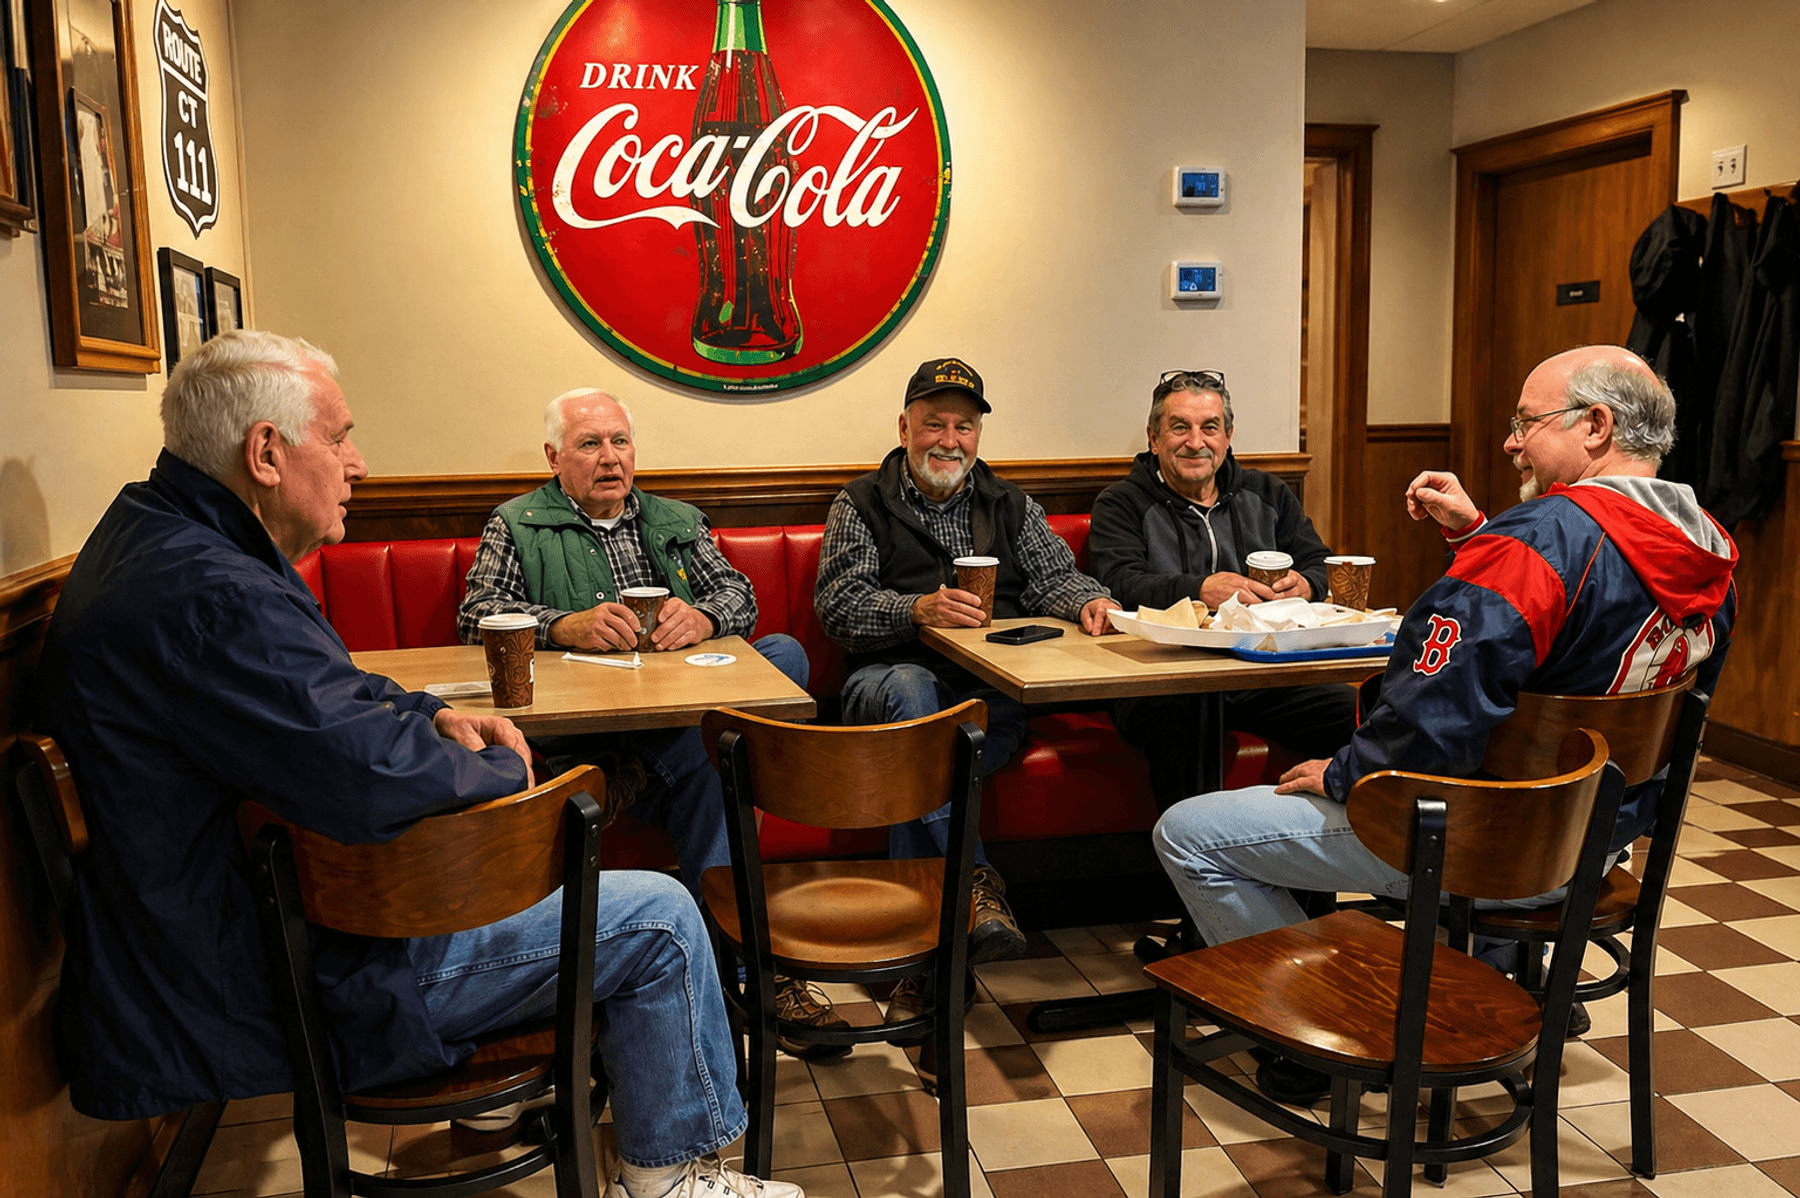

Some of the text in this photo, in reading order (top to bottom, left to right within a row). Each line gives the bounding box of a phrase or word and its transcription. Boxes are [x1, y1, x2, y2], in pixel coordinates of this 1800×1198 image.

[162, 20, 202, 85] ROUTE
[579, 62, 699, 91] DRINK
[177, 90, 198, 129] CT
[173, 131, 212, 206] 111
[552, 103, 919, 230] Coca-Cola
[1413, 613, 1462, 676] B
